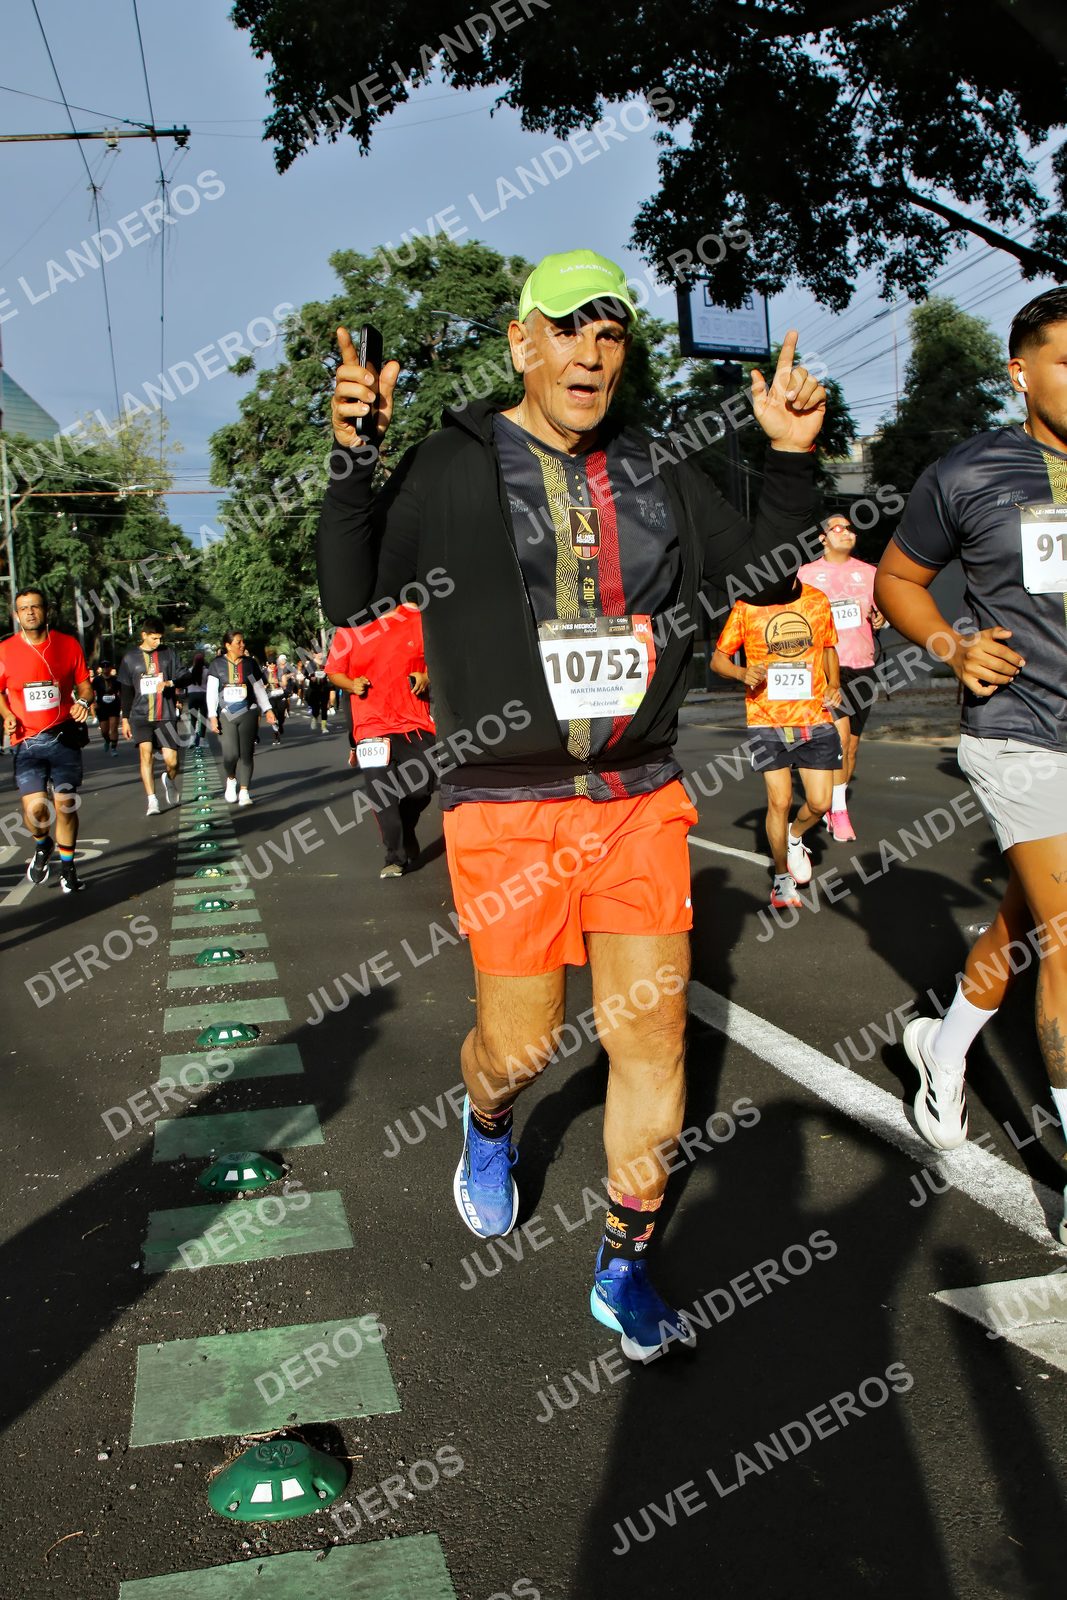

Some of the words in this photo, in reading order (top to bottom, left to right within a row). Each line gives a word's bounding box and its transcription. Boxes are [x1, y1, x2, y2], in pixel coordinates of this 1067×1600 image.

[836, 607, 858, 619] 1263
[545, 647, 642, 684] 10752
[774, 673, 805, 686] 9275
[29, 690, 54, 701] 8236
[358, 746, 385, 757] 10850
